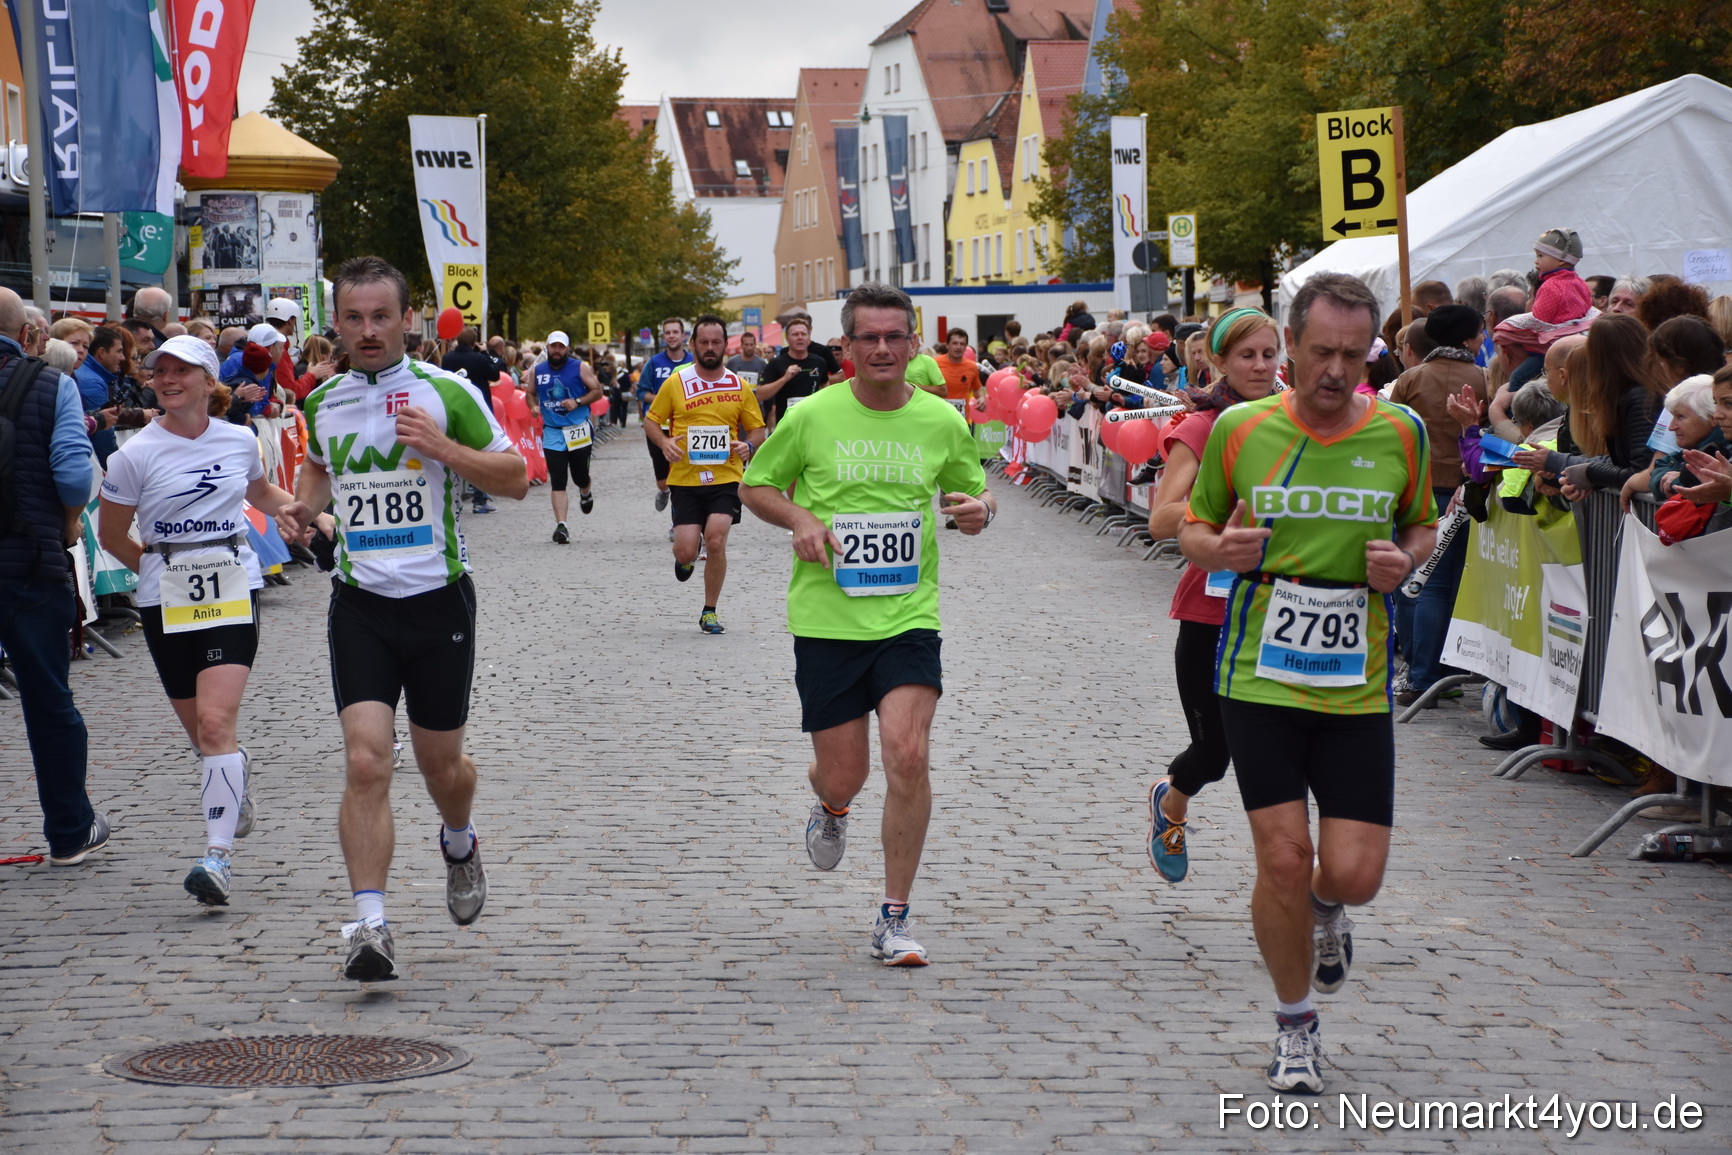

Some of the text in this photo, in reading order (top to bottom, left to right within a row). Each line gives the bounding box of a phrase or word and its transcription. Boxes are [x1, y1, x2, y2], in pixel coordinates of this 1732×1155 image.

[1327, 113, 1394, 141] Block
[1340, 147, 1385, 212] B
[447, 265, 479, 278] Block
[451, 281, 473, 311] C
[220, 317, 248, 326] CASH
[593, 321, 606, 338] D
[536, 373, 551, 386] 13
[655, 366, 671, 379] 12
[685, 392, 744, 411] MAX BÖGL
[1123, 411, 1146, 421] BMW
[569, 427, 586, 440] 271
[692, 435, 727, 450] 2704
[834, 440, 925, 463] NOVINA
[836, 463, 925, 486] HOTELS
[340, 479, 413, 491] PARTL Neumarkt
[347, 490, 424, 527] 2188
[1252, 485, 1396, 523] BOCK
[154, 519, 236, 537] SpoCom.de
[835, 521, 909, 530] PARTL Neumarkt
[359, 531, 415, 548] Reinhard
[843, 532, 916, 565] 2580
[1420, 509, 1466, 577] bmw-laufsport
[166, 559, 232, 573] ARTL Neumarkt
[187, 571, 221, 602] 31
[857, 571, 902, 585] Thomas
[1275, 588, 1355, 609] PARTL Neumarkt
[193, 607, 222, 620] Anita
[1273, 606, 1360, 649] 2793
[1284, 653, 1342, 672] Helmuth
